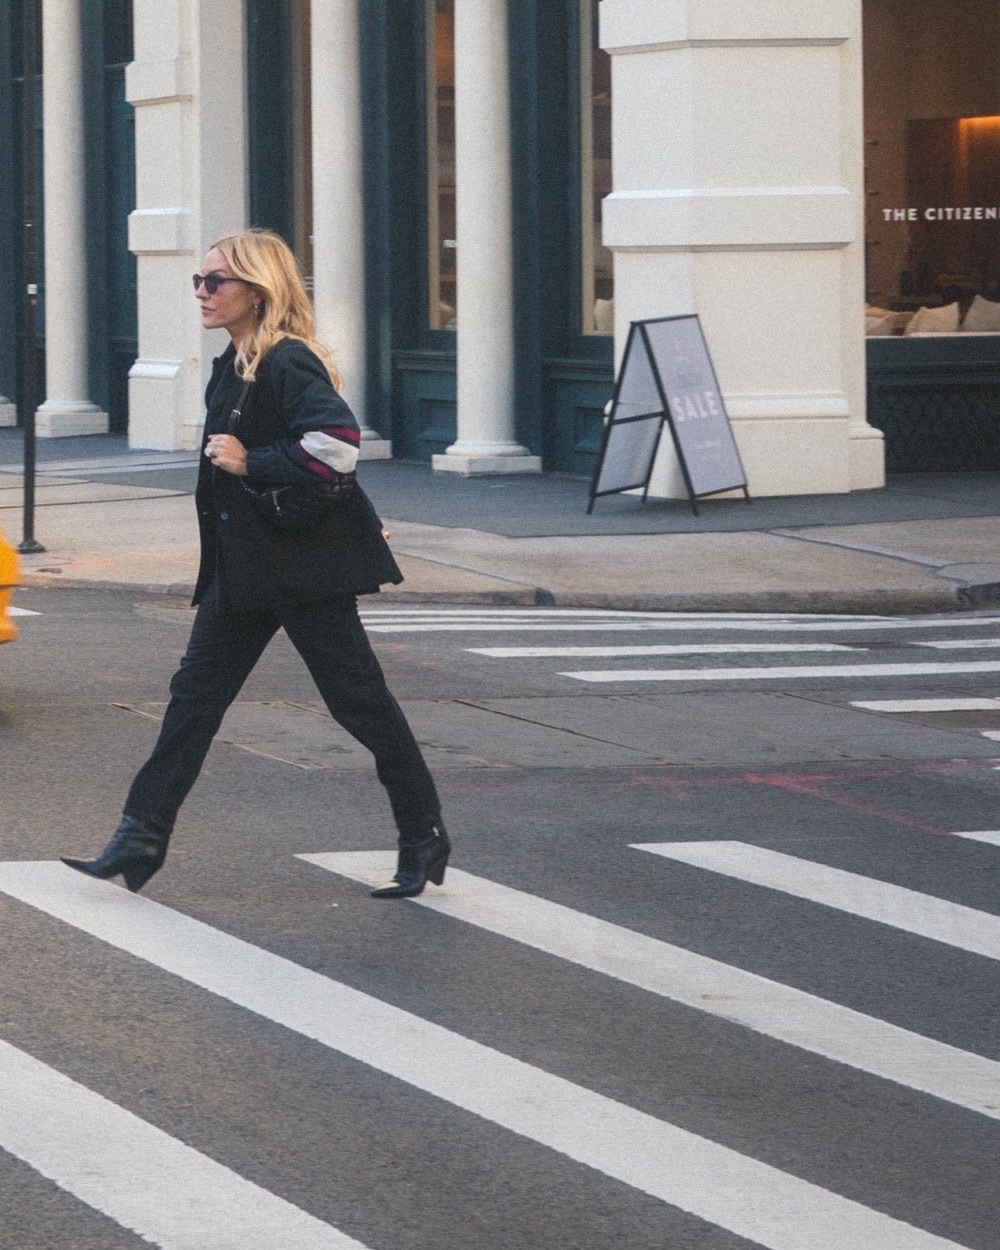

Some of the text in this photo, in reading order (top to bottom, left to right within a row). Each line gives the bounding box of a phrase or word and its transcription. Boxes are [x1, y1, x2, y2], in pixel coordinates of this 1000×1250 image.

[882, 207, 1000, 221] THE CITIZEN
[672, 391, 720, 422] SALE
